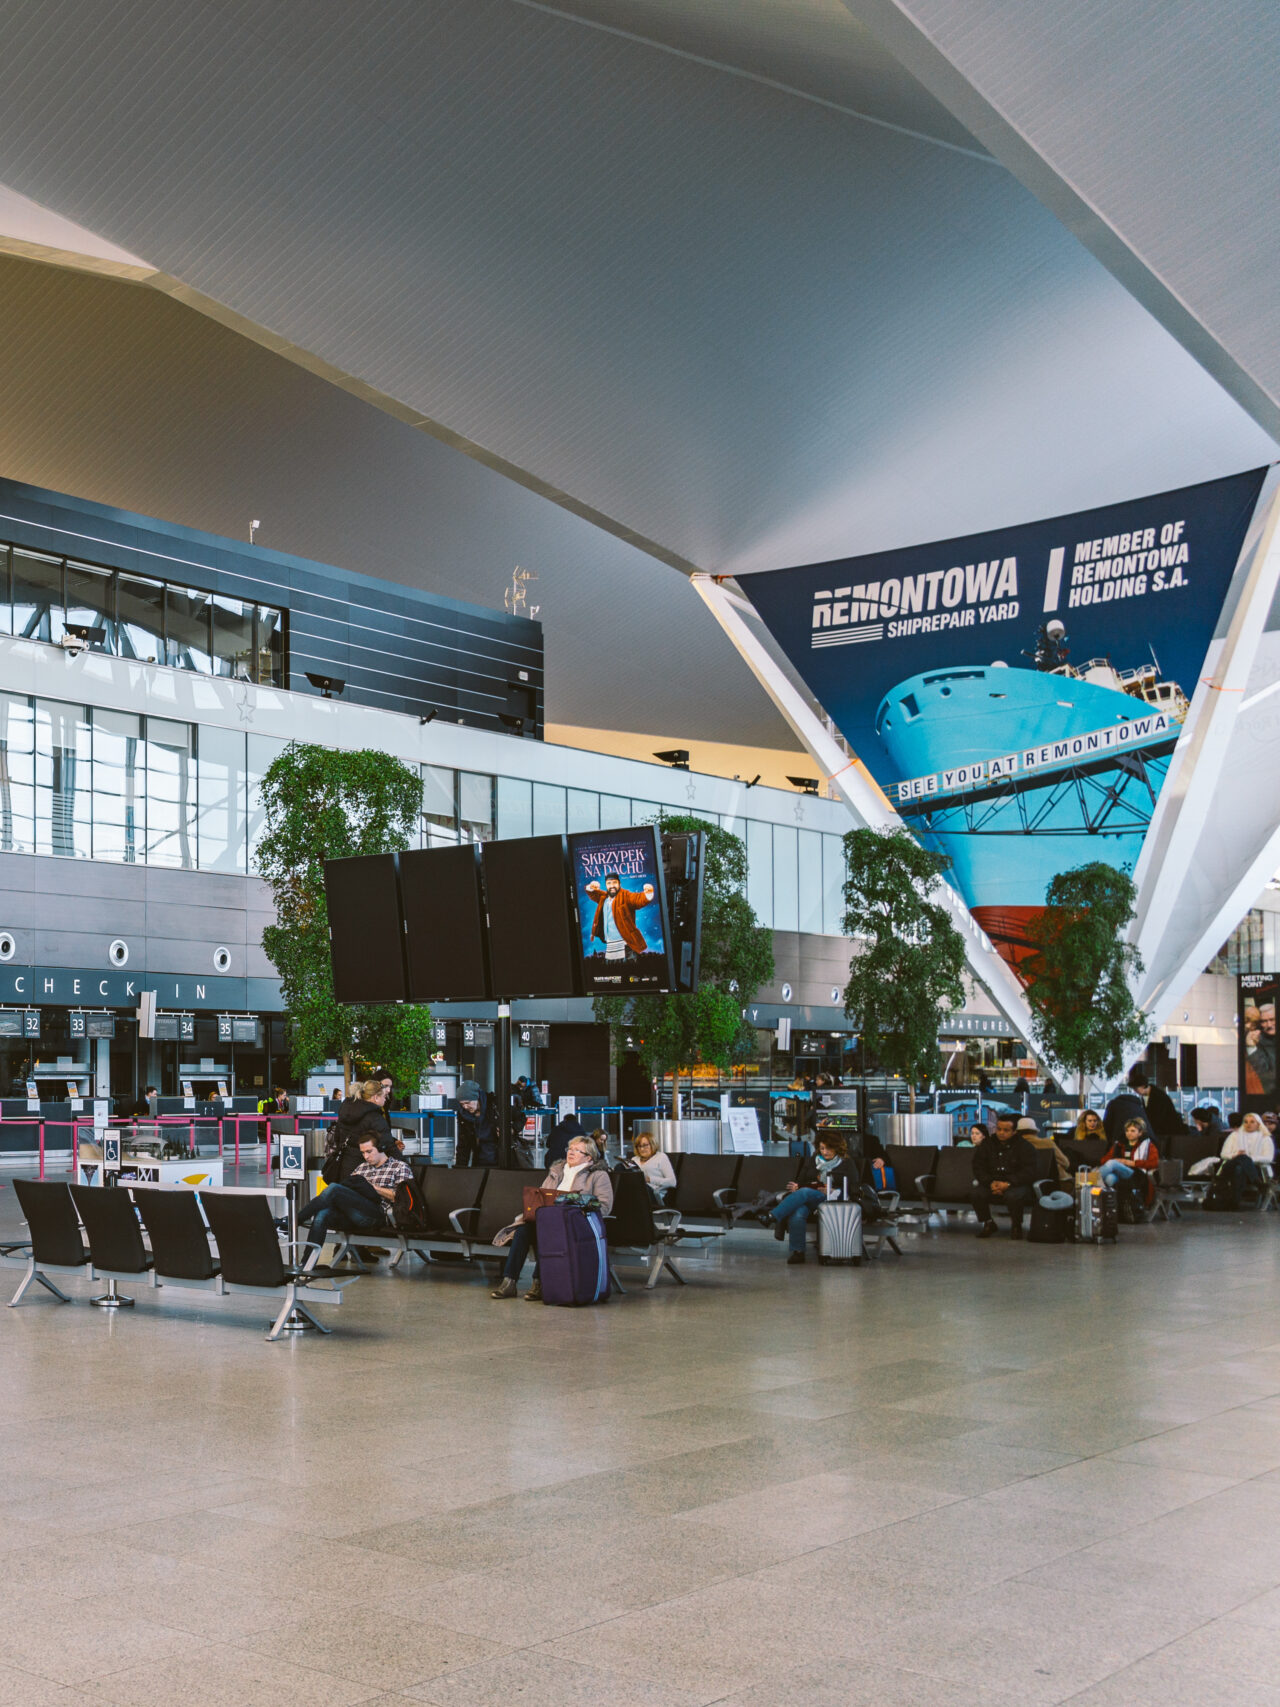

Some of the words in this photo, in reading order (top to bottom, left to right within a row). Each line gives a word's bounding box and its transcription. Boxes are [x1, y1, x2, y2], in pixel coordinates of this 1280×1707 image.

[1074, 528, 1155, 563] MEMBER
[1160, 520, 1185, 545] OF
[1071, 543, 1189, 586] REMONTOWA
[812, 557, 1018, 628] REMONTOWA
[1068, 574, 1147, 608] HOLDING
[1151, 567, 1189, 592] S.A.
[887, 609, 975, 638] SHIPREPAIR
[978, 601, 1019, 624] YARD
[900, 778, 934, 797] SEE
[946, 766, 982, 786] YOU
[991, 757, 1016, 774] AT
[1025, 716, 1166, 767] REMONTOWA
[581, 848, 645, 867] SKRZYPEK
[584, 865, 602, 878] NA
[604, 860, 644, 876] DACHU
[26, 1018, 38, 1030] 32
[72, 1019, 84, 1030] 33
[181, 1021, 193, 1033] 34
[220, 1023, 231, 1034] 35
[943, 1019, 1010, 1031] EPARTURES
[436, 1029, 445, 1039] 38
[465, 1030, 473, 1040] 39
[521, 1031, 530, 1041] 40
